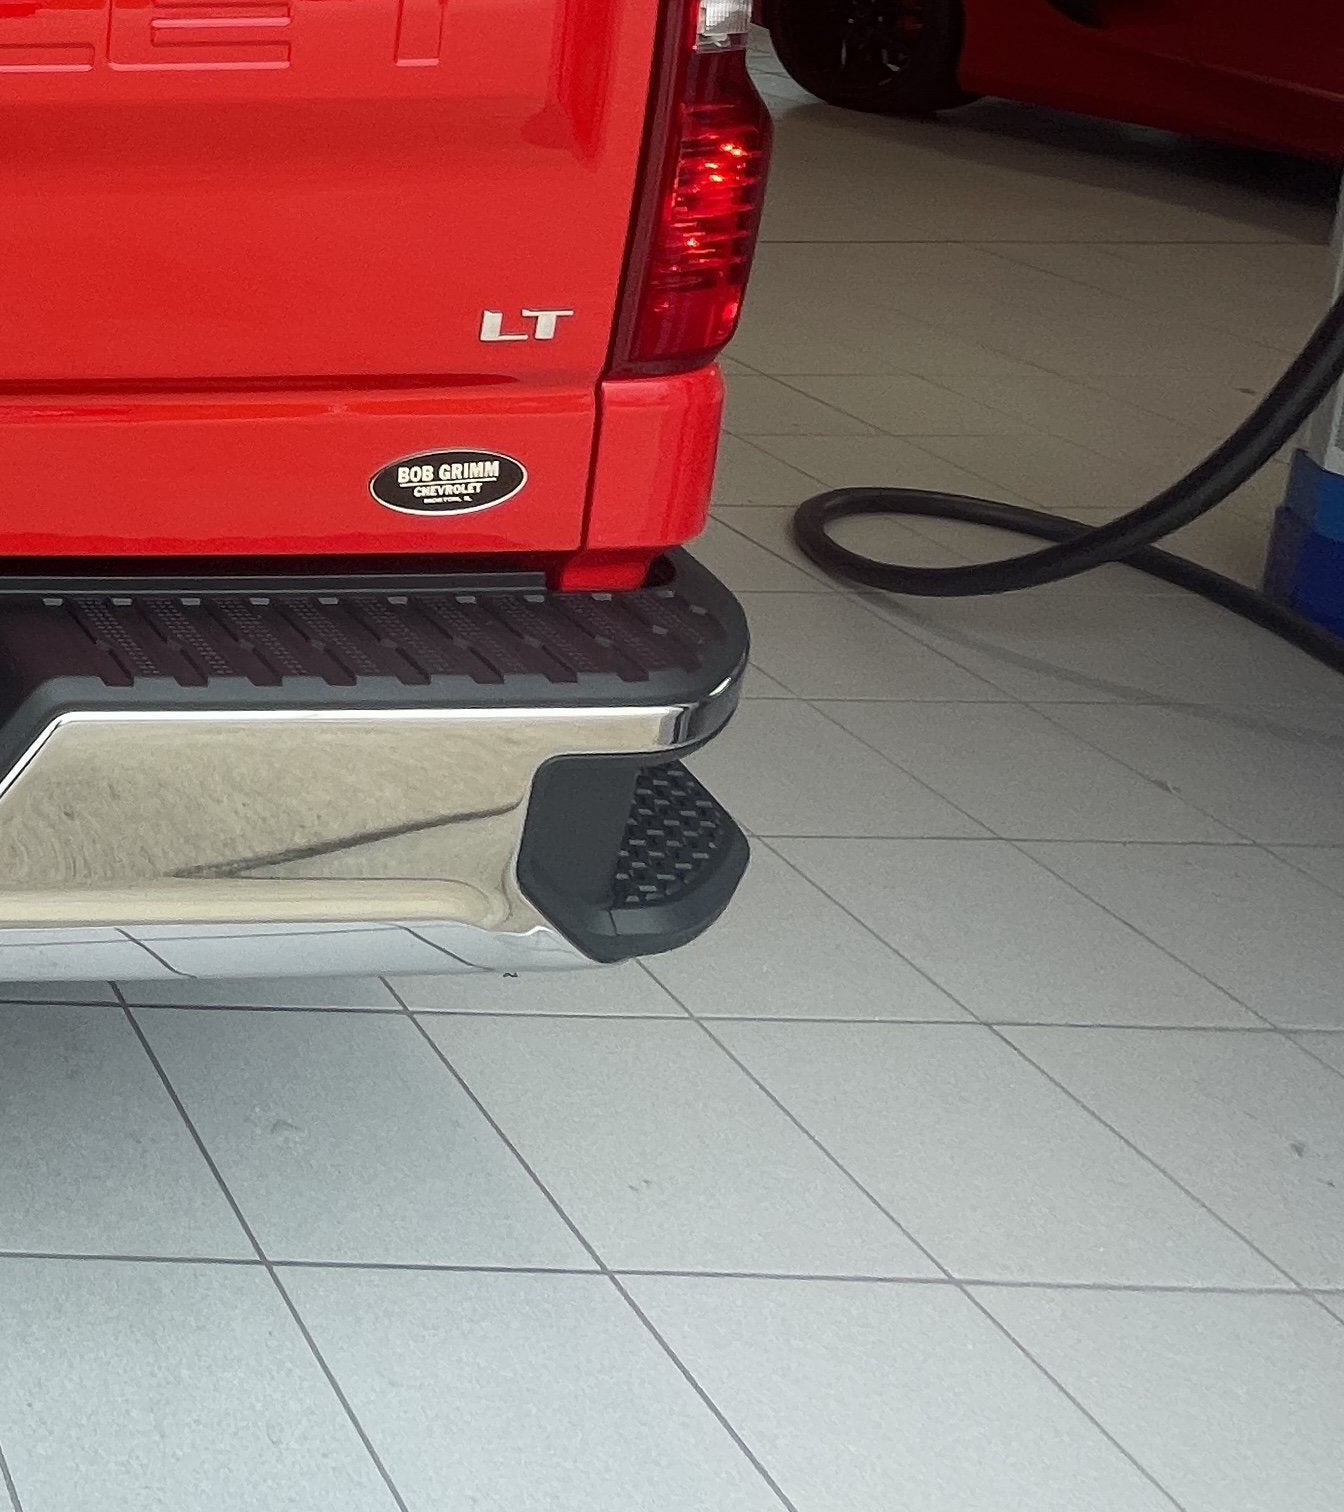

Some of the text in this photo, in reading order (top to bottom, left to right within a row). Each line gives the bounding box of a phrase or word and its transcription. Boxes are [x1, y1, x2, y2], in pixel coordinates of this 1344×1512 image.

[479, 309, 574, 341] LT
[398, 461, 500, 483] BOB GRIMM
[413, 483, 483, 497] CHEVROLET
